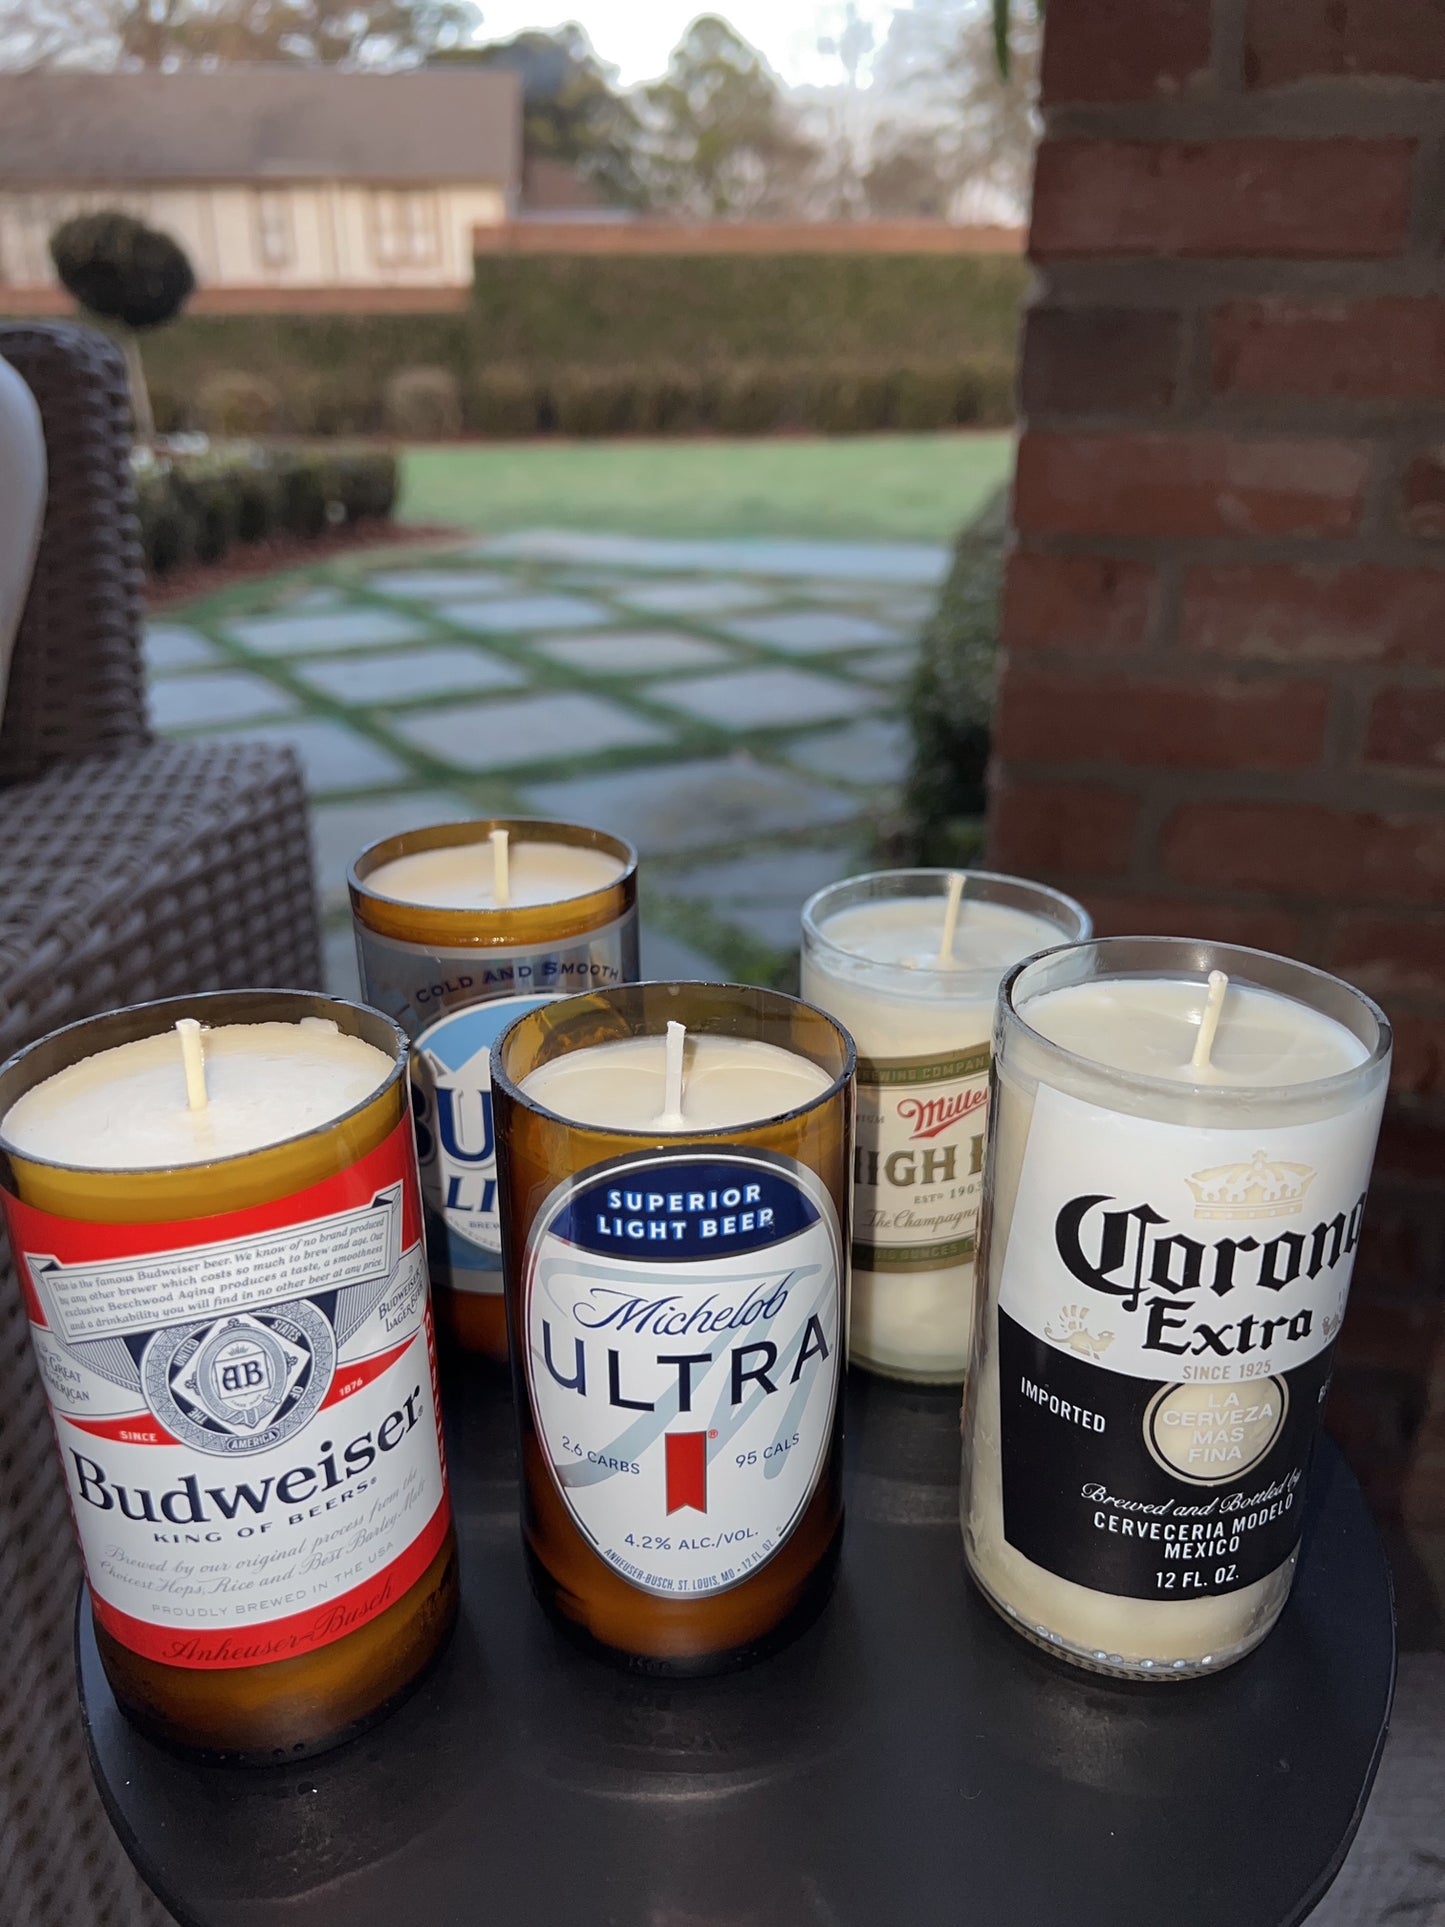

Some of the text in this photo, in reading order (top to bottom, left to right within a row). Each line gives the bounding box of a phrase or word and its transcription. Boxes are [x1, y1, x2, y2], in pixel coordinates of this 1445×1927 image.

[416, 961, 620, 1004] COLD AND SMOOTH
[922, 1056, 985, 1078] COMPAN
[607, 1184, 761, 1211] SUPERIOR
[597, 1208, 775, 1240] LIGHT BEER
[893, 1206, 977, 1232] Champagn
[89, 1290, 116, 1301] other
[118, 1283, 158, 1297] brewer
[162, 1276, 198, 1290] which
[201, 1268, 236, 1282] costs
[236, 1266, 250, 1275] so
[253, 1256, 286, 1271] much
[289, 1253, 301, 1263] to
[304, 1245, 331, 1259] brew
[331, 1239, 350, 1252] and
[95, 1275, 134, 1289] famous
[137, 1263, 201, 1281] Budweiser
[203, 1256, 232, 1270] beer.
[235, 1252, 252, 1262] We
[255, 1244, 287, 1258] know
[289, 1239, 302, 1250] of
[304, 1238, 318, 1247] no
[320, 1226, 348, 1242] brand
[350, 1216, 385, 1235] produced
[1054, 1192, 1367, 1312] Corona
[65, 1303, 105, 1318] exclusive
[108, 1294, 174, 1312] Beechwood
[178, 1285, 215, 1300] Aging
[220, 1274, 277, 1291] produces
[291, 1262, 321, 1274] taste,
[332, 1245, 384, 1265] smoothness
[95, 1309, 160, 1327] drinkability
[162, 1305, 185, 1318] you
[187, 1298, 210, 1312] will
[213, 1293, 242, 1308] find
[242, 1287, 254, 1300] in
[258, 1286, 273, 1296] no
[275, 1278, 305, 1293] other
[308, 1271, 330, 1285] beer
[332, 1268, 343, 1278] at
[378, 1267, 421, 1320] BUDWEISER
[572, 1270, 795, 1335] Michelob
[271, 1319, 302, 1342] STATES
[1141, 1296, 1313, 1356] Extra
[173, 1338, 200, 1367] UNITED
[542, 1313, 829, 1413] ULTRA
[1182, 1360, 1272, 1380] SINCE 1925
[222, 1360, 264, 1392] AB
[338, 1377, 364, 1397] 1876
[1021, 1376, 1106, 1433] IMPORTED
[1162, 1403, 1273, 1427] CERVEZA
[1208, 1391, 1240, 1408] LA
[69, 1385, 422, 1524] Budweiser
[119, 1430, 158, 1442] SINCE
[230, 1431, 277, 1449] AMERICA
[561, 1436, 641, 1475] 2.6 CARBS
[735, 1433, 800, 1468] 95 CALS
[1188, 1445, 1243, 1464] FINA
[1192, 1427, 1245, 1445] MAS
[153, 1481, 370, 1544] KING OF BEERS
[1080, 1482, 1174, 1516] Brewed
[1172, 1497, 1220, 1516] and
[1219, 1472, 1289, 1514] Bottled
[105, 1544, 166, 1572] Brewed
[175, 1559, 195, 1577] by
[200, 1561, 229, 1573] our
[235, 1539, 305, 1575] original
[313, 1514, 365, 1551] process
[369, 1487, 400, 1523] from
[1093, 1492, 1294, 1541] CERVECERIA MODELO
[101, 1560, 153, 1591] Choicest
[198, 1576, 254, 1595] Rice
[259, 1569, 295, 1586] and
[298, 1548, 344, 1575] Best
[346, 1511, 402, 1553] Barley
[624, 1528, 759, 1550] 4.2% ALC./VOL.
[1164, 1535, 1241, 1560] MEXICO
[152, 1541, 395, 1617] PROUDLY BREWED IN THE USA
[604, 1548, 676, 1592] ANHEUSER-BUSCH,
[678, 1580, 690, 1591] ST.
[721, 1568, 736, 1582] MO
[1155, 1564, 1240, 1589] 12 FL. OZ.
[162, 1573, 393, 1662] Anheuser-Busch
